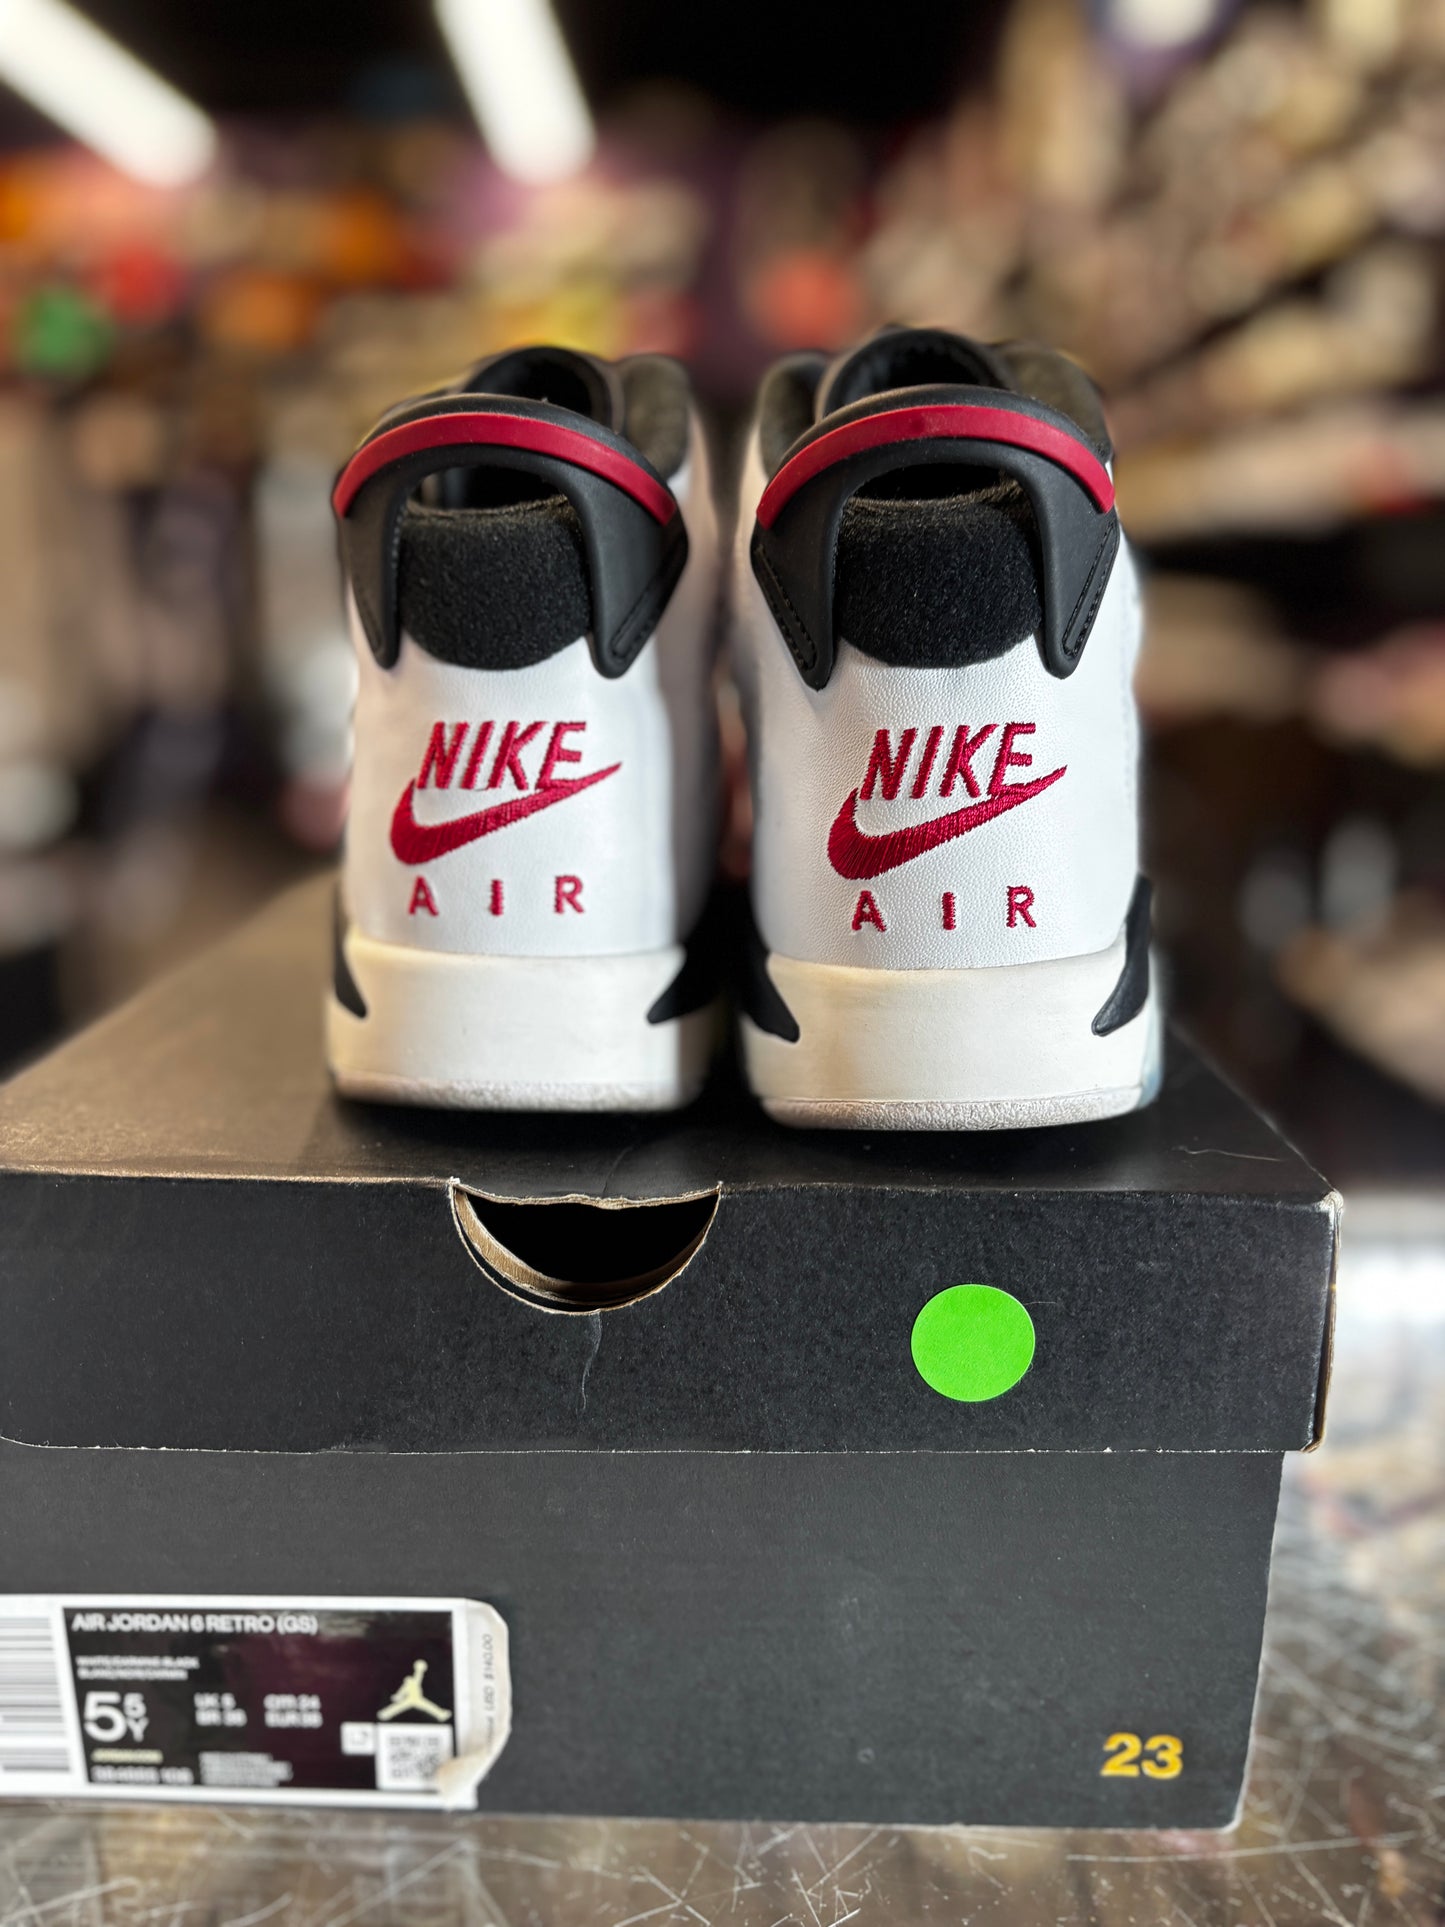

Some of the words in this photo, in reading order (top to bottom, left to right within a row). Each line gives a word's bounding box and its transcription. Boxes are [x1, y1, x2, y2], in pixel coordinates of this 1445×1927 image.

[416, 720, 587, 791] NIKE
[858, 721, 1037, 801] NIKE
[409, 875, 585, 917] AIR
[852, 885, 1037, 932] AIR
[71, 1613, 106, 1632] AIR
[106, 1613, 189, 1633] JORDAN
[190, 1614, 205, 1633] 6
[205, 1614, 275, 1633] RETRO
[276, 1615, 319, 1636] (GS)
[84, 1691, 127, 1742] 5
[1100, 1731, 1183, 1780] 23
